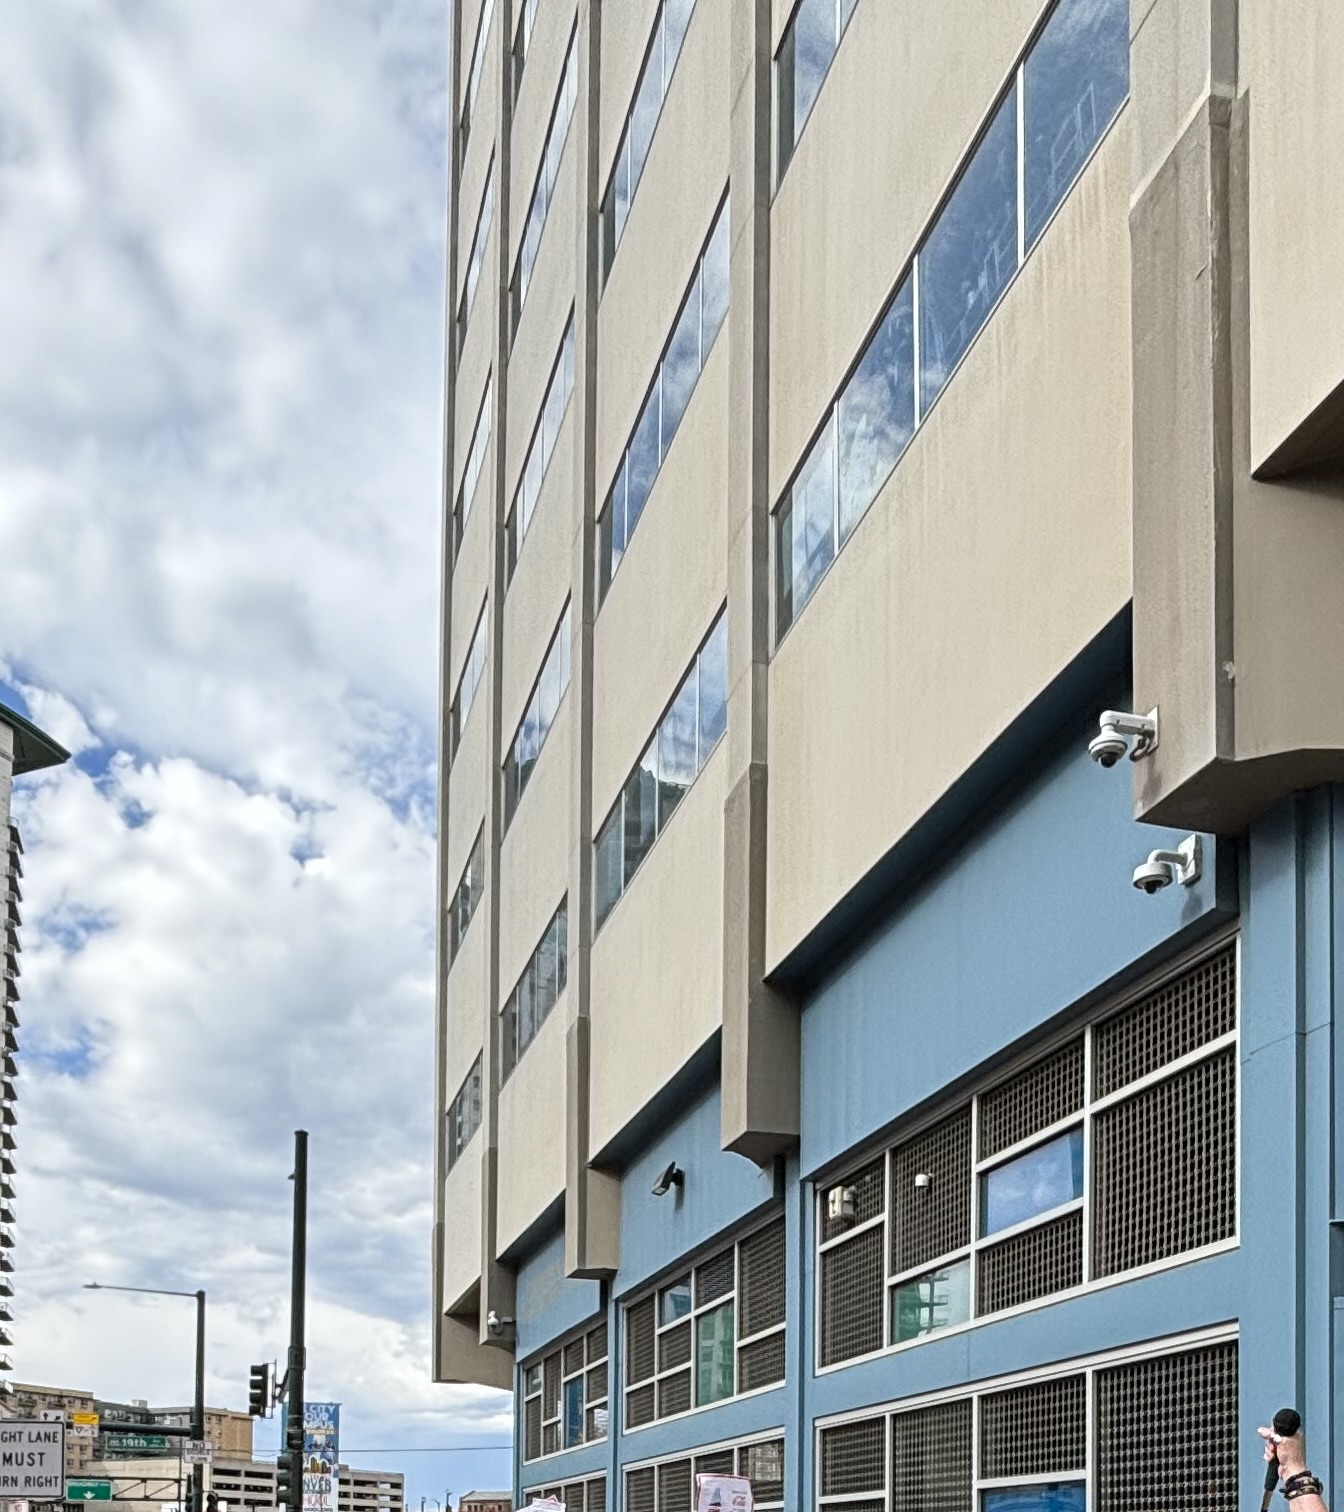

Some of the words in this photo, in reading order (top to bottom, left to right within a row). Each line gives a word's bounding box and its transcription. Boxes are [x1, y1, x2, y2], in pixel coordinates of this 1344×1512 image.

[310, 1405, 336, 1414] CITY
[304, 1413, 330, 1421] OUR
[303, 1420, 335, 1429] MPUS
[27, 1430, 59, 1444] LANE
[122, 1438, 147, 1448] 19th
[2, 1452, 46, 1467] MUST
[24, 1475, 60, 1488] RIGHT
[303, 1479, 332, 1494] NVER
